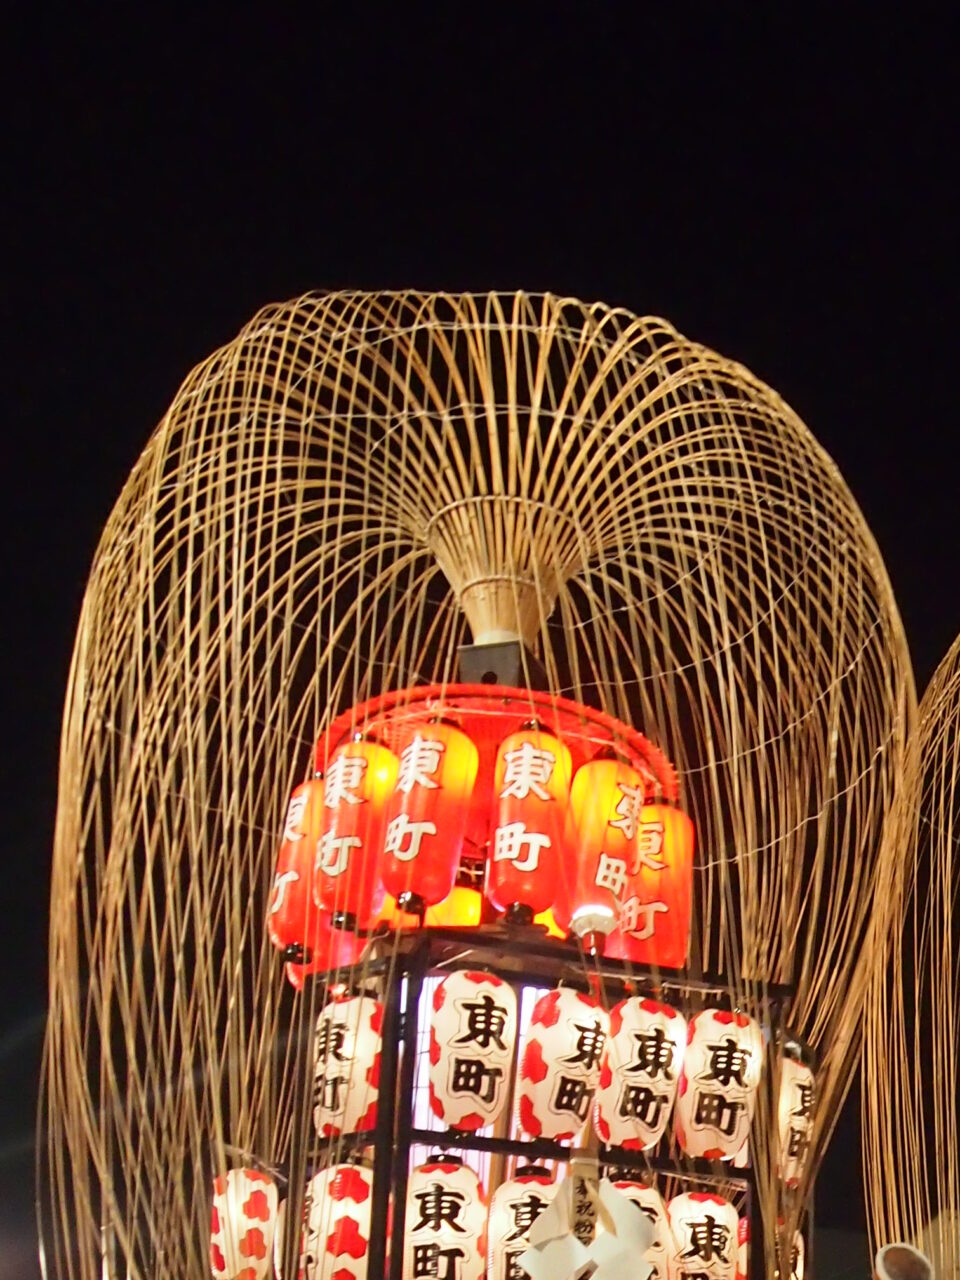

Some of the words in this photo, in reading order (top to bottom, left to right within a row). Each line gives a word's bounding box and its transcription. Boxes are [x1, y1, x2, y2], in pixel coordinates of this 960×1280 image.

[316, 753, 369, 877] 東町
[383, 735, 446, 863] 東町
[493, 741, 557, 872] 東町
[451, 995, 508, 1105] 東町
[555, 1020, 607, 1122] 東町
[618, 1027, 678, 1129] 東町
[694, 1038, 753, 1137] 東町
